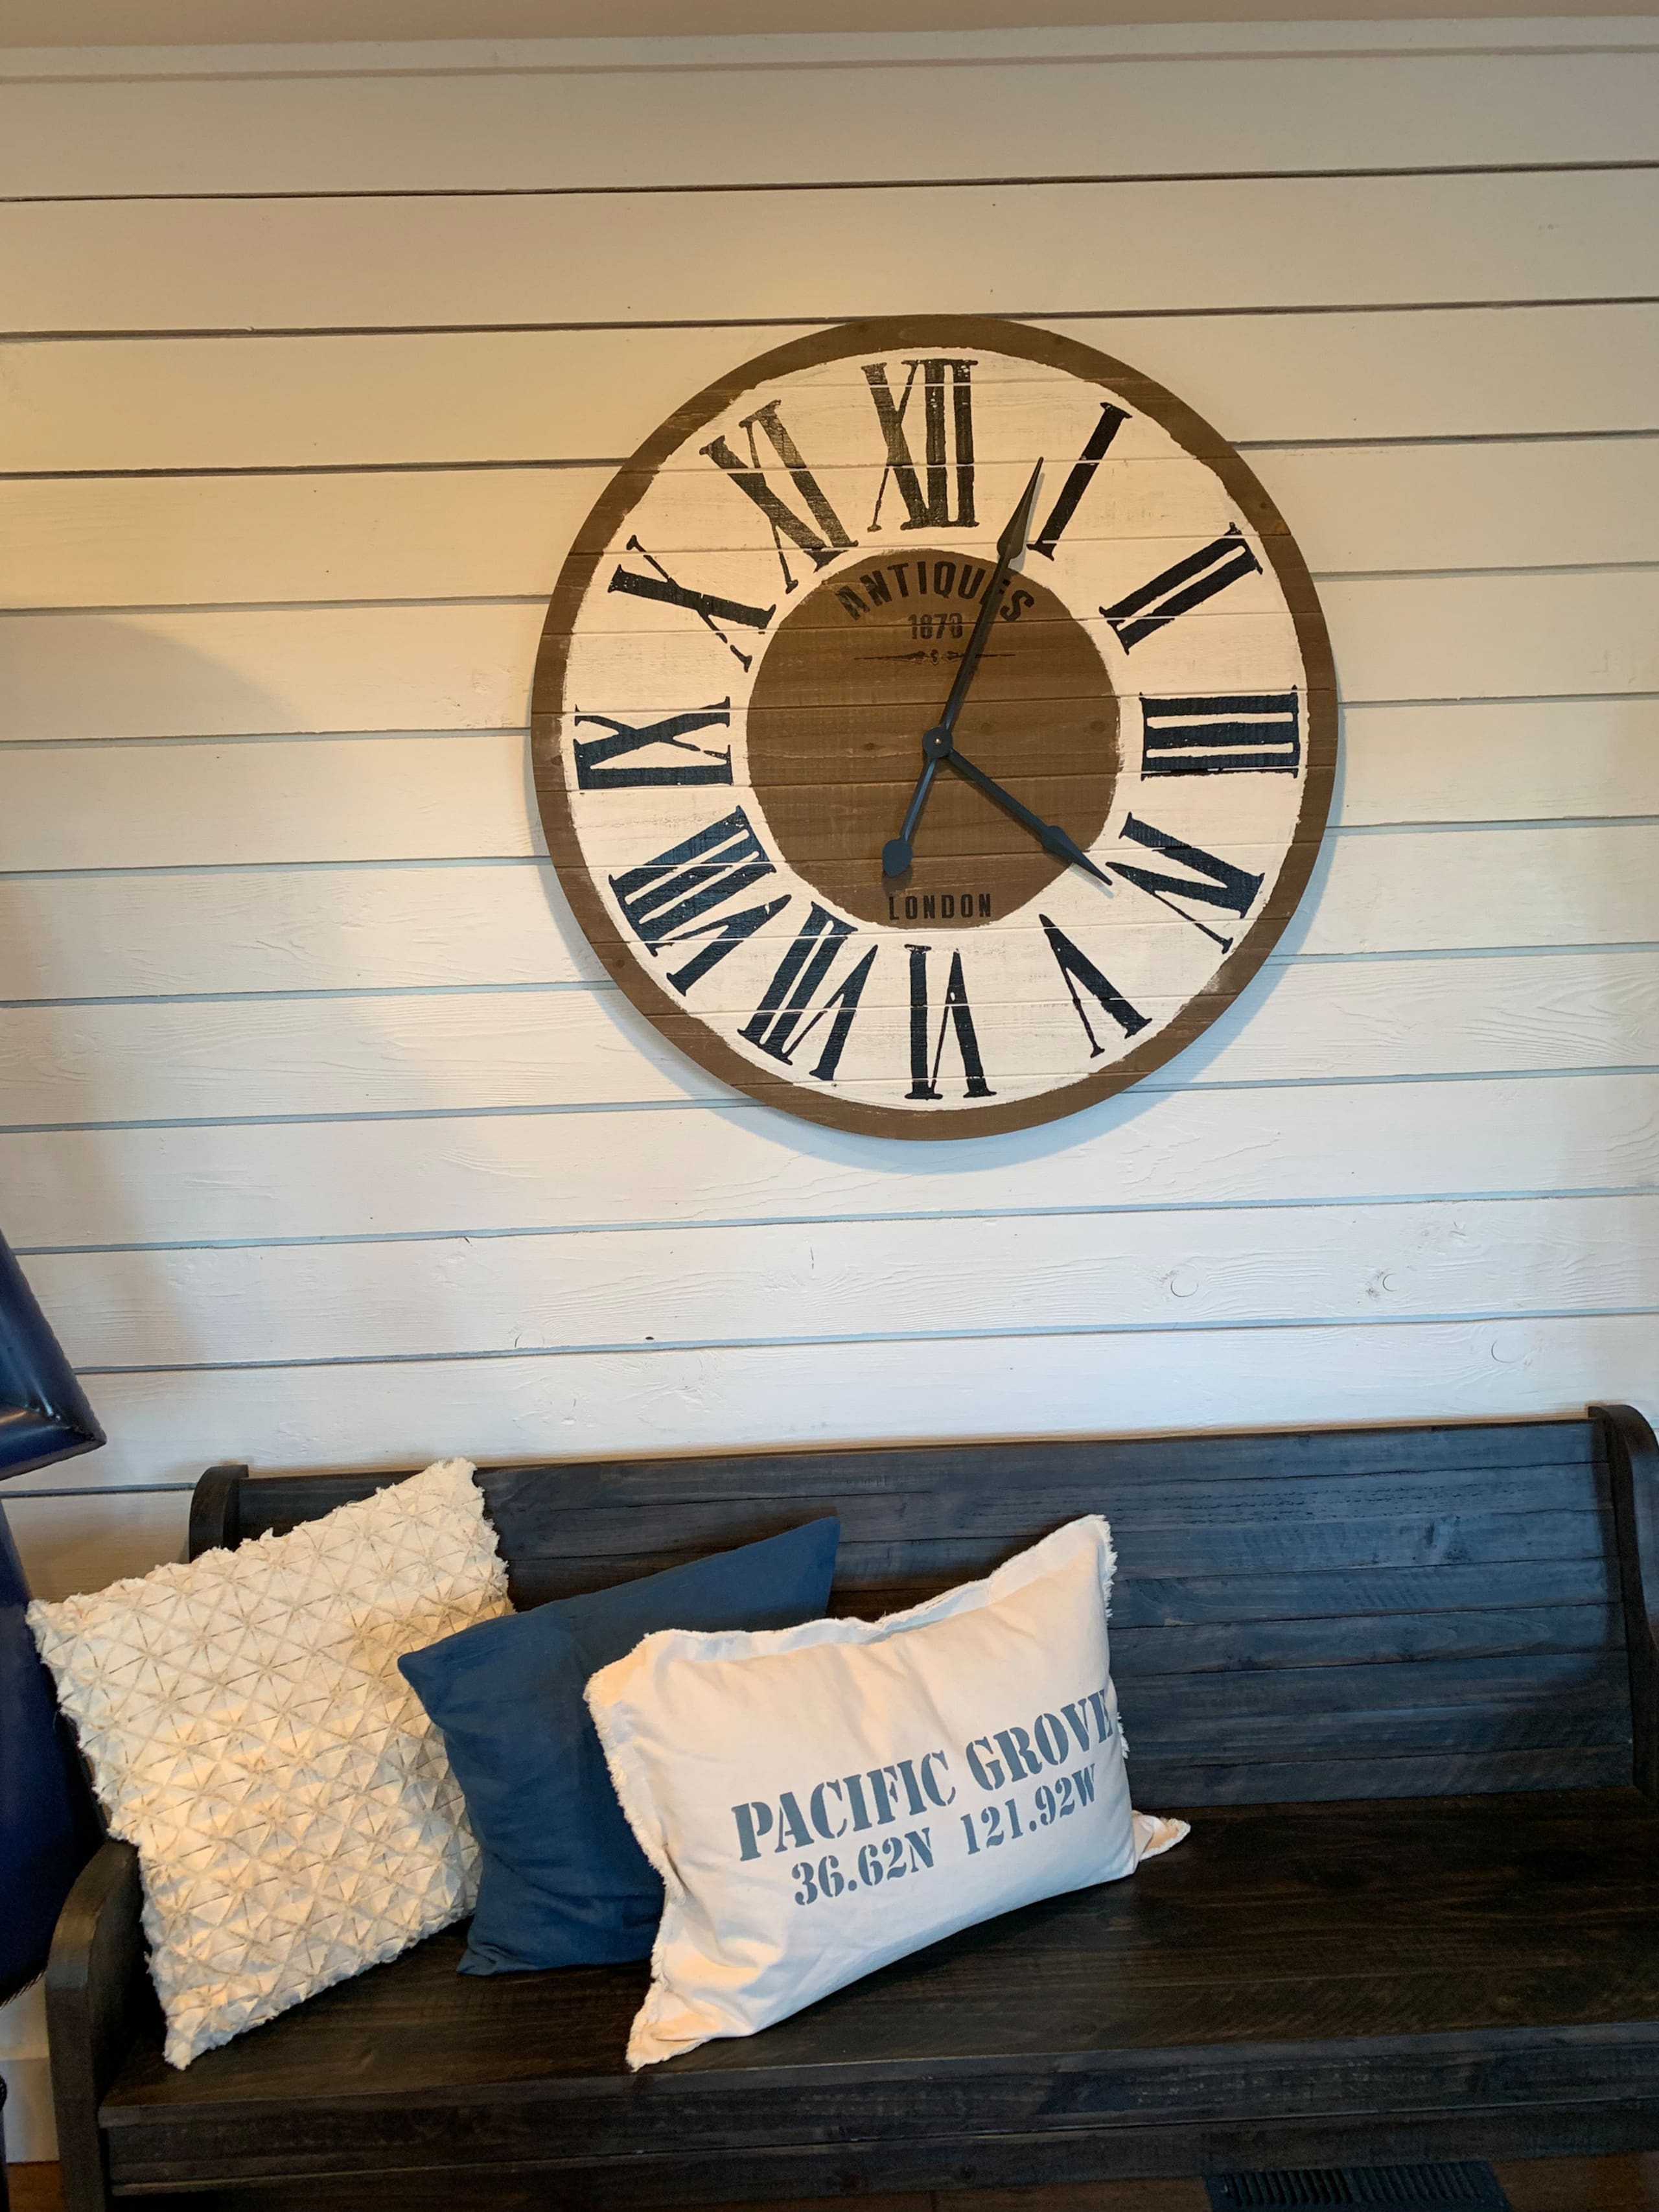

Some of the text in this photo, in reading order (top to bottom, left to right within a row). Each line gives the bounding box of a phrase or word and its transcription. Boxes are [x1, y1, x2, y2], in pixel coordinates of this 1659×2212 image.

[699, 399, 860, 594] XI
[861, 358, 980, 533] XII
[1027, 401, 1133, 562] I
[607, 535, 776, 673] X
[1098, 522, 1264, 656] II
[574, 695, 734, 791] IX
[1139, 685, 1301, 780] III
[608, 804, 792, 997] VIII
[888, 893, 992, 920] LONDON
[1105, 811, 1266, 955] IV
[737, 901, 878, 1081] VII
[904, 944, 997, 1100] VI
[1039, 914, 1153, 1060] V
[731, 1688, 1113, 1861] PACIFIC GROVE
[791, 1762, 1095, 1906] 36.62N 121.92W
